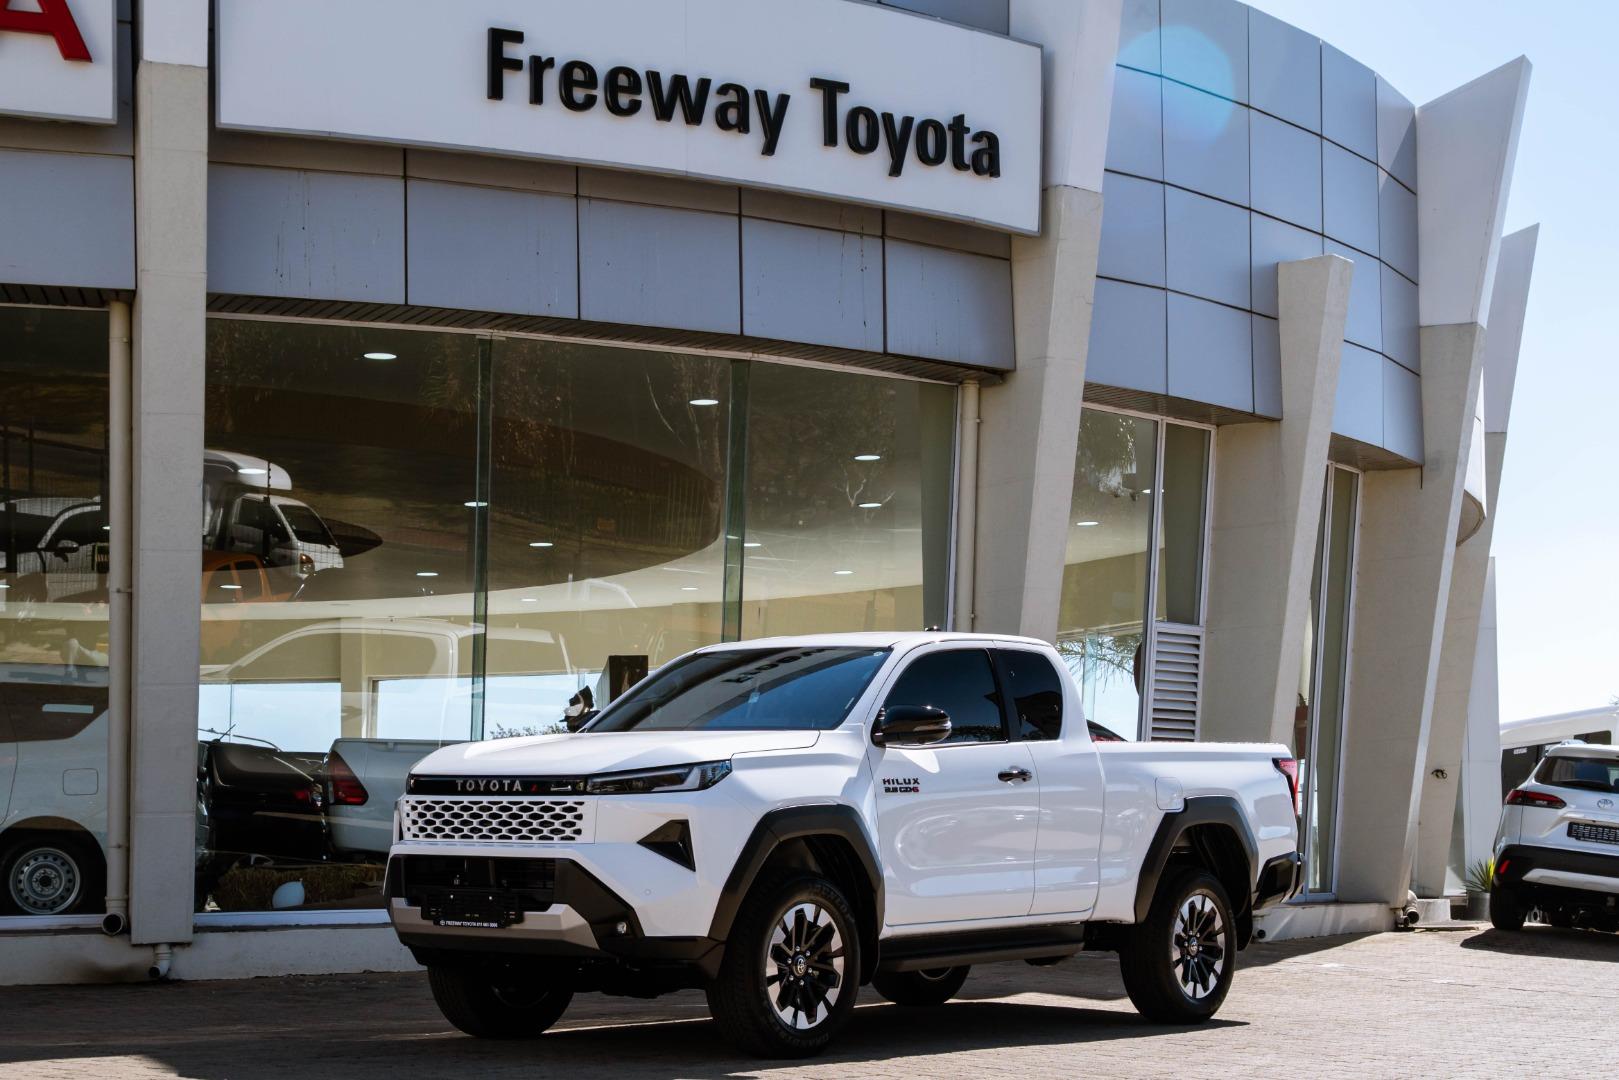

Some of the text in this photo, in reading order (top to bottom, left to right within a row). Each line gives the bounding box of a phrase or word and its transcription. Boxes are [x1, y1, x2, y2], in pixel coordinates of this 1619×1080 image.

[486, 26, 1001, 179] Freeway Toyota
[456, 779, 522, 792] TOYOTA
